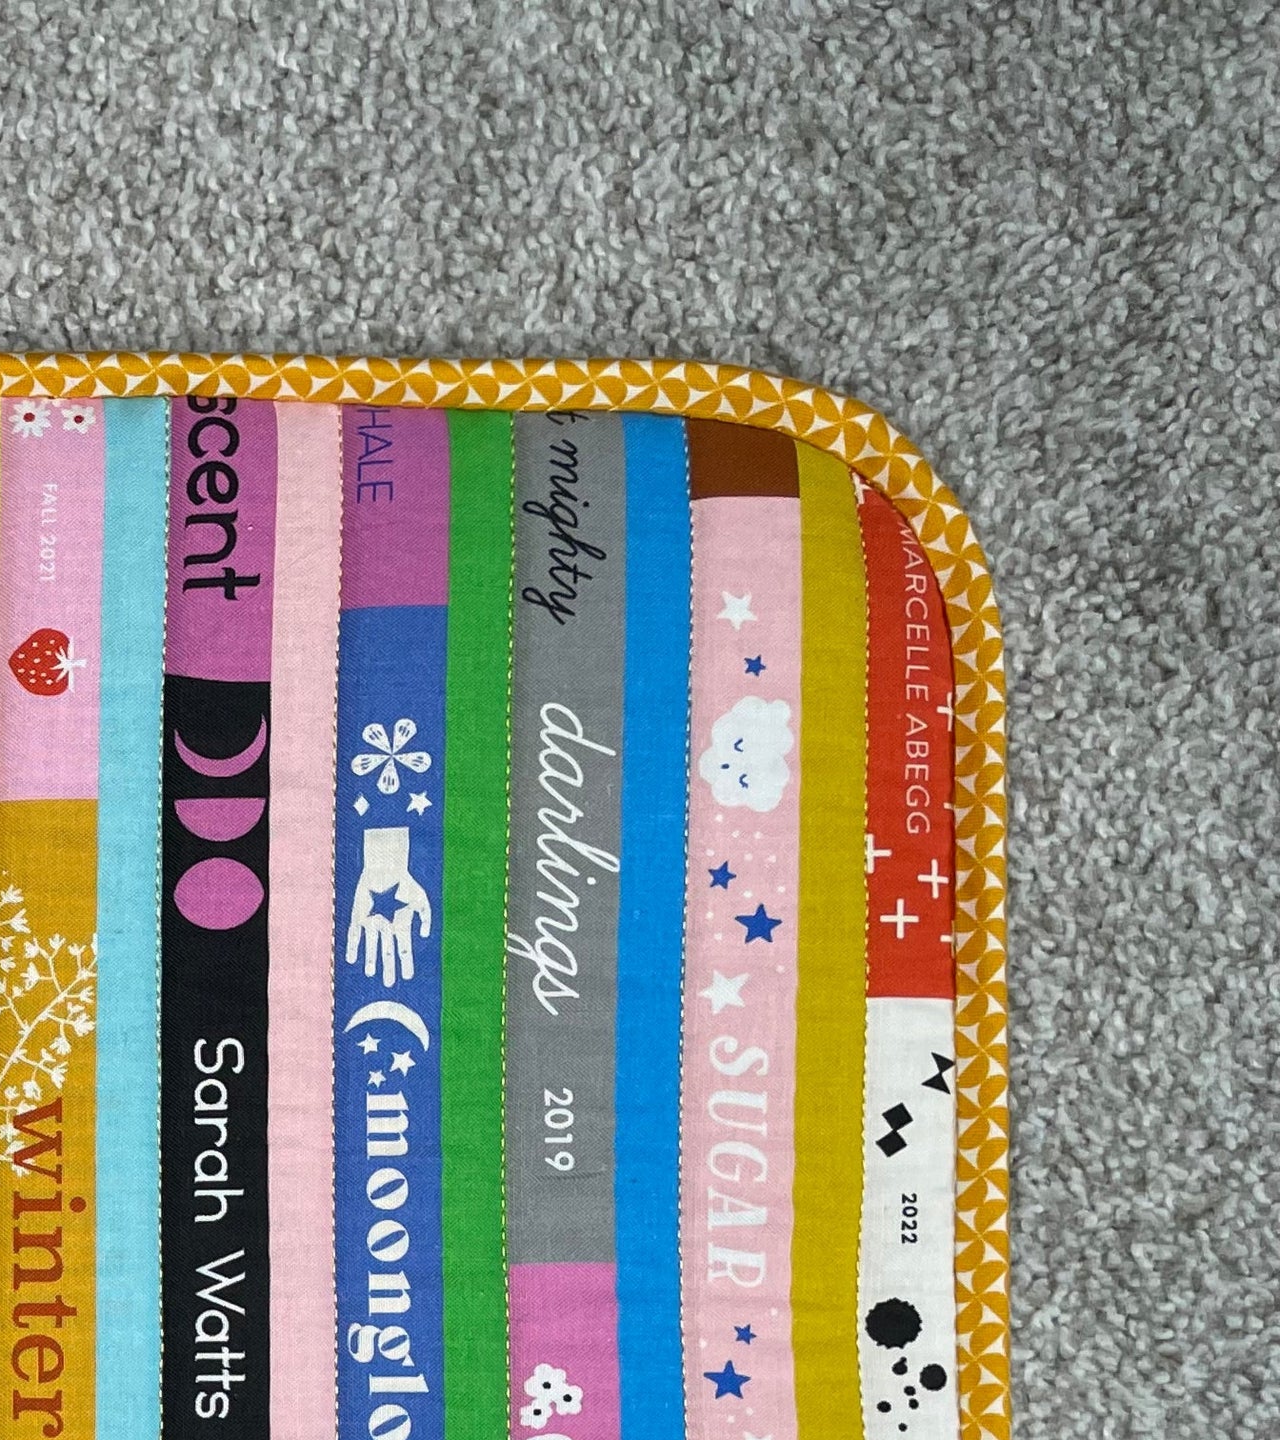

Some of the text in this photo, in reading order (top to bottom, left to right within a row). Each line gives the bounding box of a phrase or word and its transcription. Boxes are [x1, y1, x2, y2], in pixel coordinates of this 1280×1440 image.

[38, 483, 59, 583] FALL 2021
[522, 439, 607, 625] mighty
[904, 713, 930, 835] ABEGG
[507, 700, 621, 1015] darlings
[544, 1088, 574, 1172] 2019
[707, 1036, 768, 1288] SUGAR
[193, 1037, 246, 1418] Sarah Watts
[901, 1193, 918, 1245] 2022
